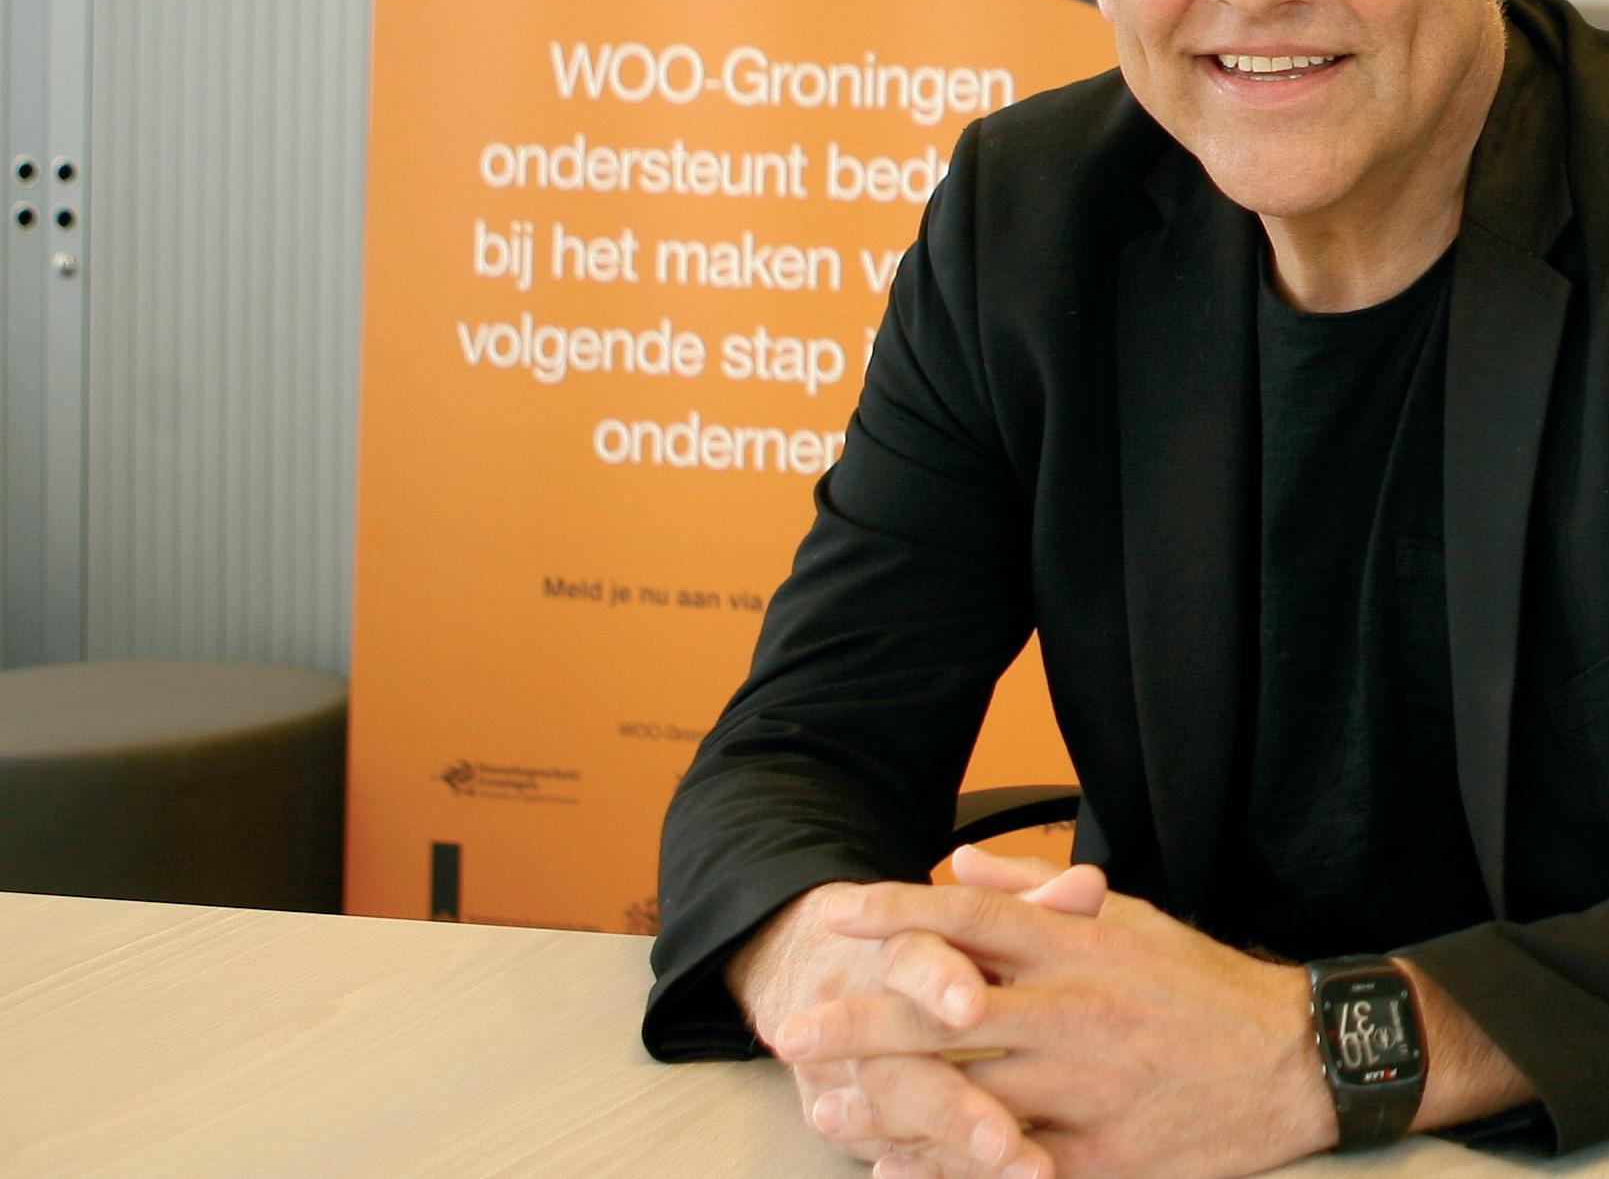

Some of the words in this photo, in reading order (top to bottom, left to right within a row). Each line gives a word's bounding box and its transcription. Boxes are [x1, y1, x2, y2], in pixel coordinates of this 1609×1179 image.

[549, 40, 1014, 125] WOO-Groningen
[478, 134, 809, 198] ondersteunt
[472, 219, 535, 289] bij
[551, 224, 639, 283] het
[654, 230, 842, 292] maken
[456, 312, 705, 384] volgende
[720, 326, 846, 397] stap
[543, 576, 602, 601] Meld
[610, 581, 631, 606] je
[640, 587, 669, 605] nu
[679, 590, 720, 609] aan
[729, 592, 763, 612] via
